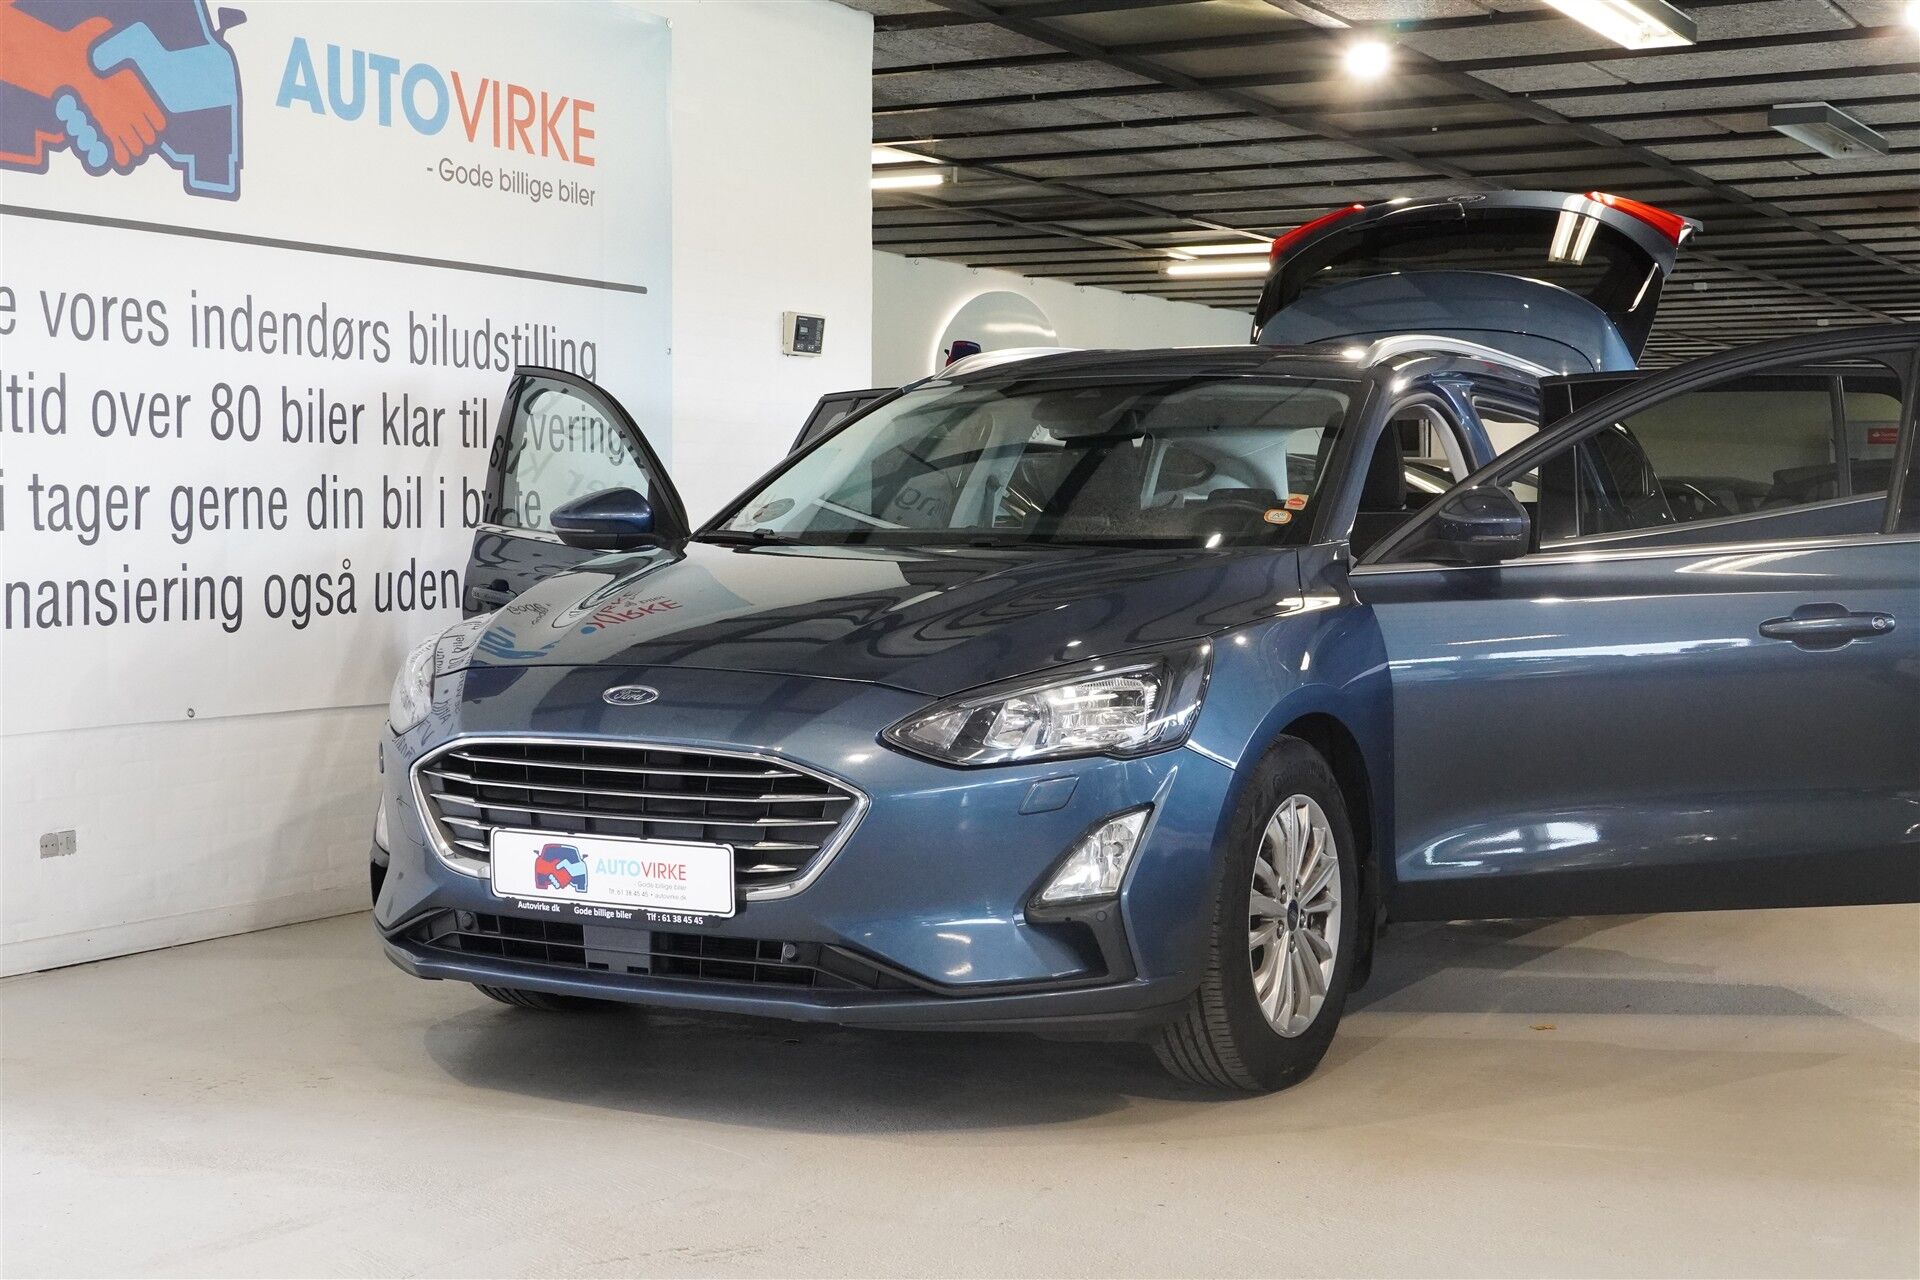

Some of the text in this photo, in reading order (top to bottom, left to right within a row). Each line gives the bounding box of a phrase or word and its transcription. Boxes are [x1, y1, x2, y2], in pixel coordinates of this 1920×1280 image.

[275, 36, 595, 167] AUTOVIRKE
[438, 157, 494, 189] Gode
[499, 168, 554, 203] billige
[558, 178, 596, 207] biler
[40, 290, 170, 347] vores
[191, 289, 391, 364] indendørs
[409, 310, 597, 383] biludstilling
[91, 389, 192, 438] over
[210, 382, 262, 442] 80
[281, 385, 365, 445] biler
[382, 391, 446, 448] klar
[458, 396, 488, 449] til
[27, 473, 152, 546] tager
[170, 485, 288, 545] gerne
[307, 473, 363, 530] din
[383, 474, 421, 529] bil
[439, 476, 445, 529] i
[5, 557, 460, 634] nansiering også uden
[613, 688, 647, 701] Ford
[595, 858, 687, 881] AUTOVIRKE
[517, 900, 560, 912] Autovirke dk
[573, 906, 632, 920] Gode billige biler
[646, 912, 656, 921] Tlf
[662, 913, 671, 923] 61
[672, 915, 682, 923] 38
[683, 915, 692, 924] 45
[694, 916, 704, 925] 45
